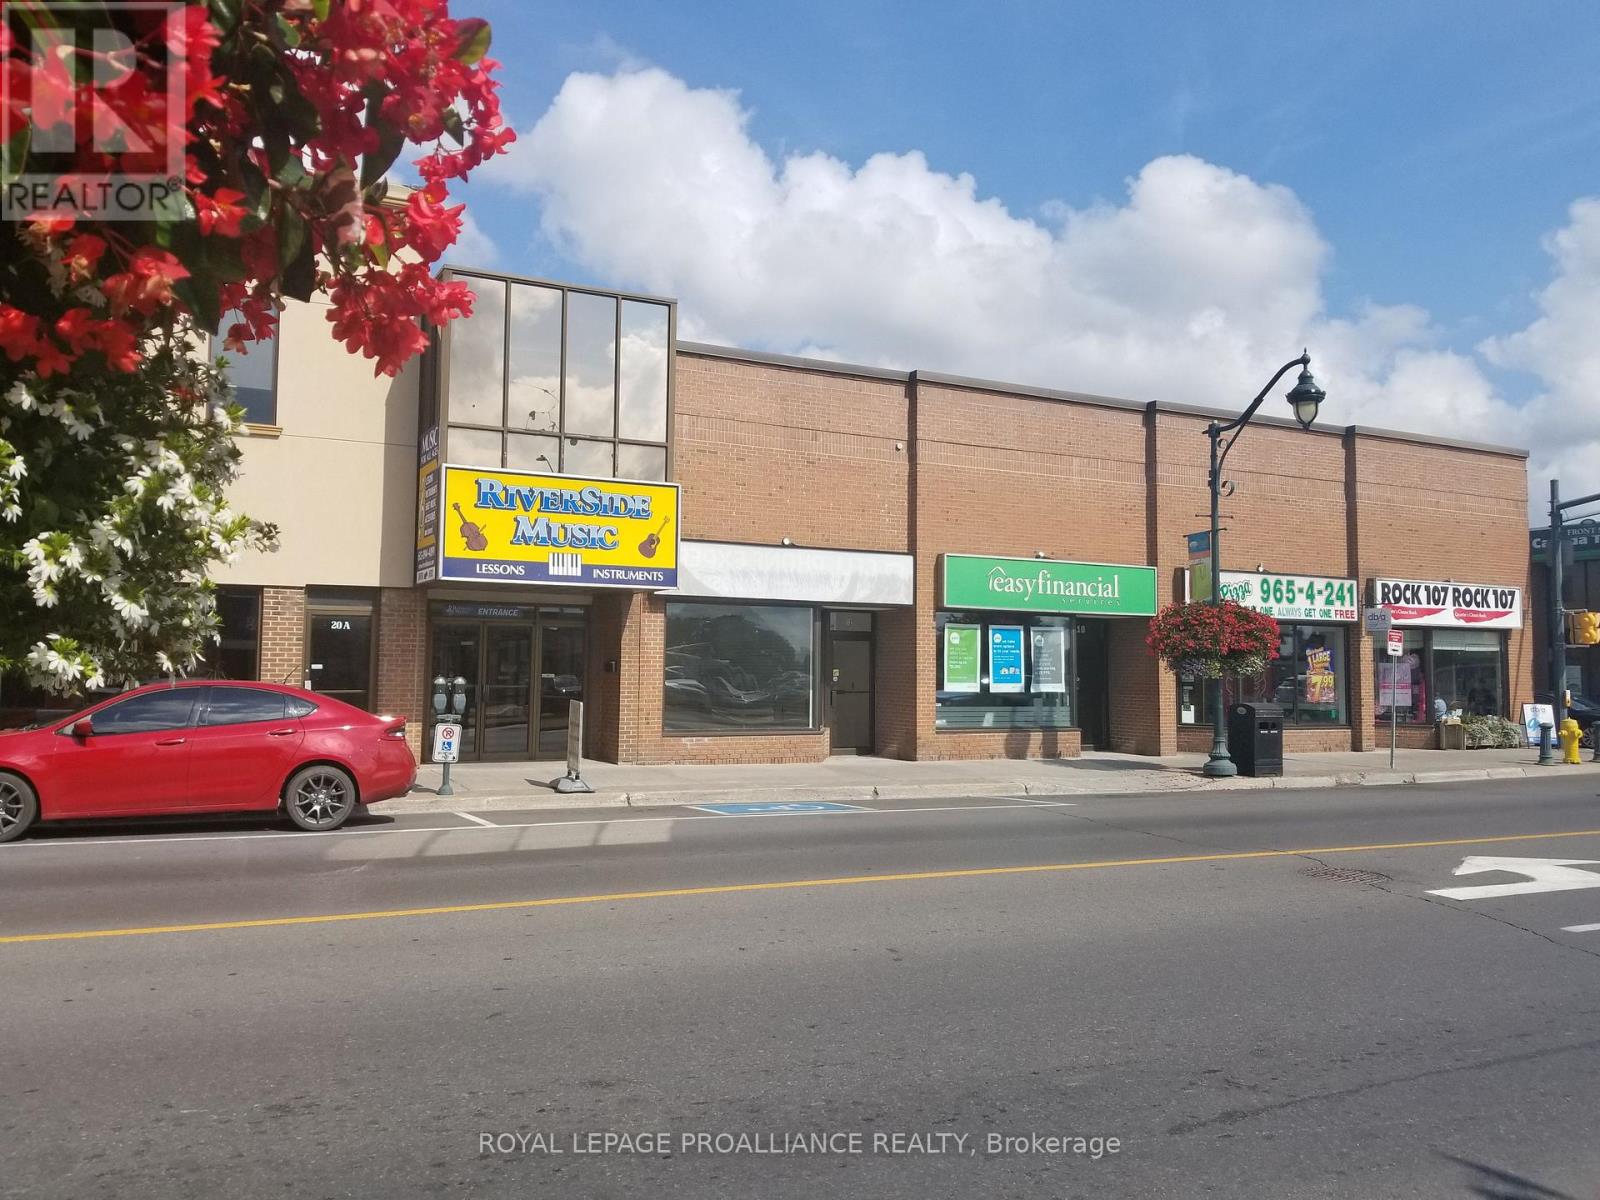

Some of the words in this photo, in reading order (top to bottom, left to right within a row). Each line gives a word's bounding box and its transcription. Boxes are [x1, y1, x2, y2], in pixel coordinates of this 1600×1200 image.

[474, 478, 652, 519] RIVERSIDE
[510, 516, 619, 550] MUSIC
[1567, 527, 1595, 536] FRONT
[476, 563, 525, 576] LESSONS
[592, 568, 664, 582] INSTRUMENTS
[994, 569, 1120, 601] easyfinancial
[1219, 578, 1252, 602] Pizza
[1260, 577, 1355, 607] 965-4-241
[1381, 582, 1422, 605] ROCK
[1424, 584, 1449, 606] 107
[1452, 587, 1490, 608] ROCK
[1492, 589, 1516, 609] 107
[477, 607, 519, 617] ENTRANCE
[1277, 607, 1302, 618] ALWAYS
[1303, 607, 1317, 618] GET
[1319, 608, 1332, 619] ONE
[1334, 609, 1356, 620] FREE
[331, 620, 342, 630] 20
[343, 621, 351, 630] A
